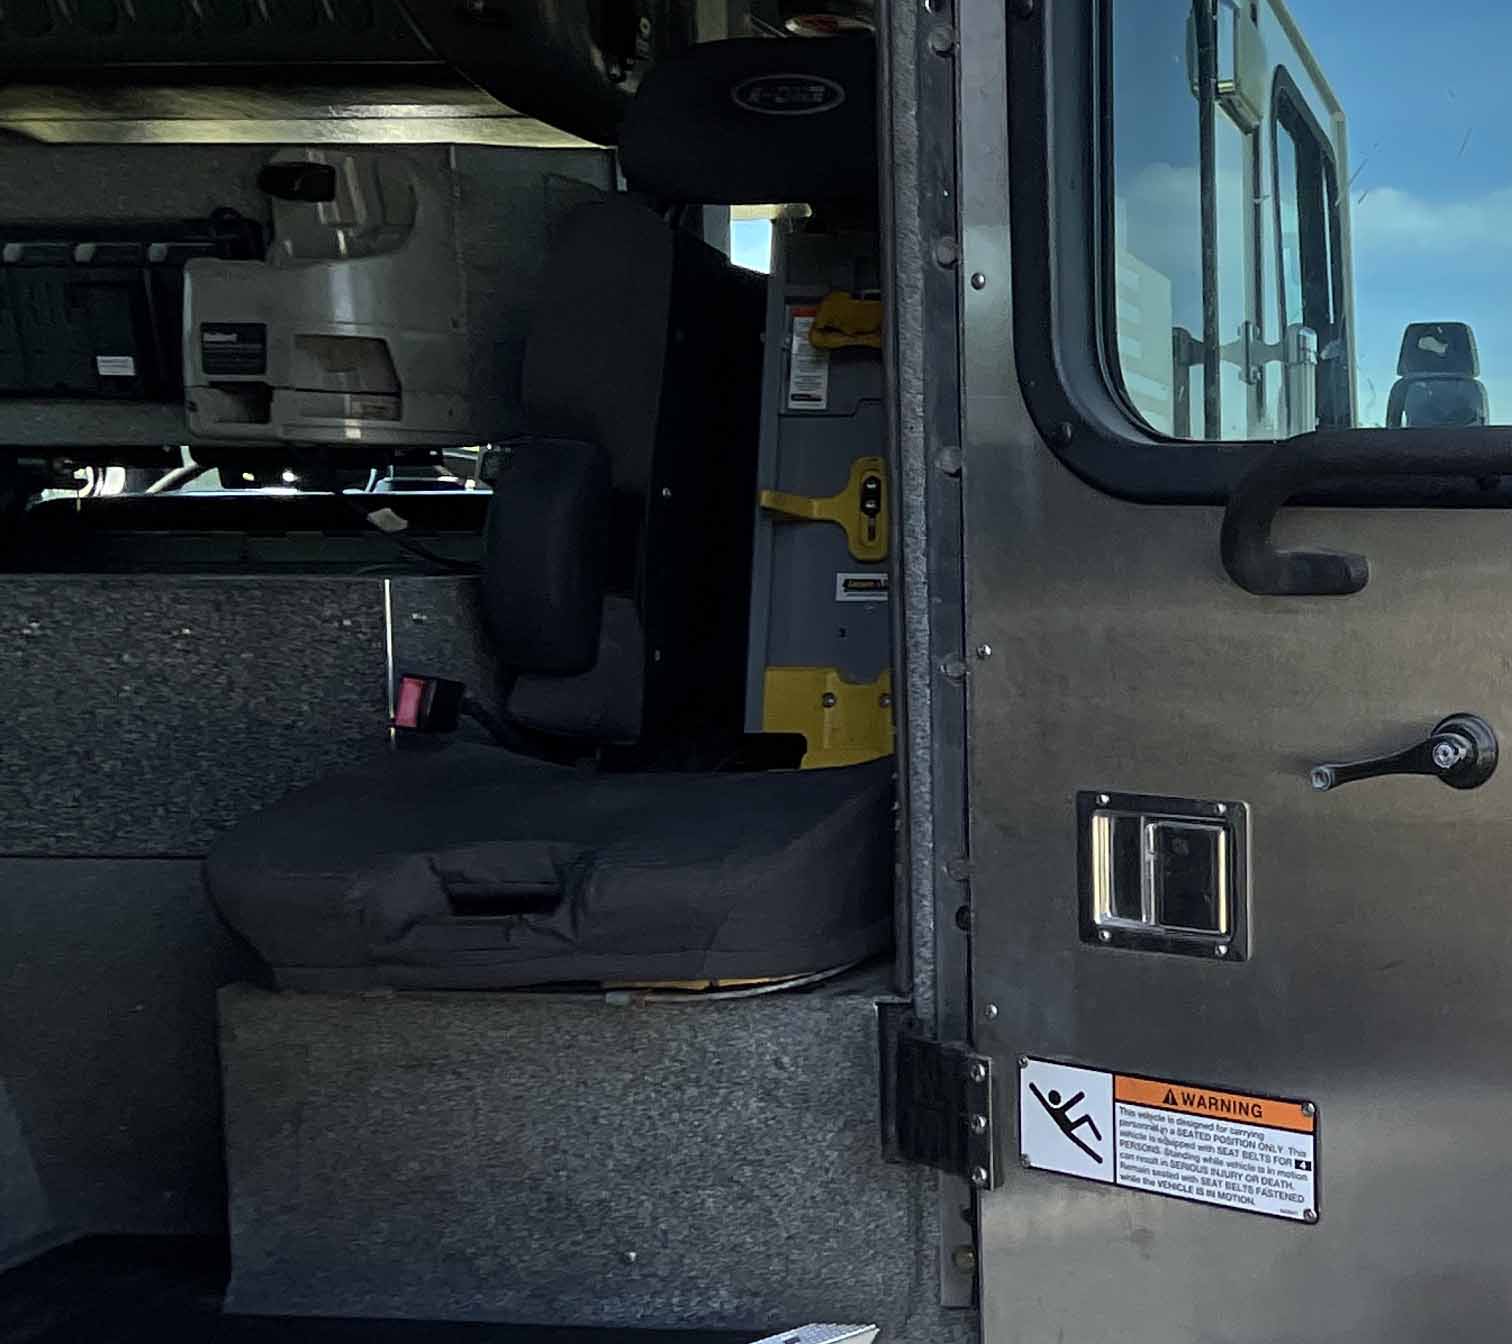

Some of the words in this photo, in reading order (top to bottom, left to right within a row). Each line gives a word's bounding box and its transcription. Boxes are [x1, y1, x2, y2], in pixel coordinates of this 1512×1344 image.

[1181, 1093, 1262, 1118] WARNING
[1119, 1106, 1135, 1116] This
[1137, 1111, 1164, 1121] vehicle
[1175, 1118, 1213, 1131] designed
[1215, 1124, 1227, 1132] for
[1230, 1128, 1264, 1140] carrying
[1119, 1130, 1146, 1140] vehicle
[1216, 1146, 1238, 1157] SEAT
[1242, 1150, 1271, 1162] BELTS
[1273, 1156, 1292, 1166] FOR
[1176, 1128, 1211, 1141] SEATED
[1213, 1134, 1255, 1148] POSITION
[1170, 1159, 1207, 1174] SERIOUS
[1210, 1167, 1243, 1180] INJURY
[1245, 1174, 1258, 1183] OR
[1226, 1160, 1255, 1171] vehicle
[1277, 1170, 1307, 1181] motion
[1142, 1177, 1155, 1186] the
[1157, 1179, 1193, 1193] VEHICLE
[1152, 1168, 1179, 1179] seated
[1200, 1176, 1223, 1188] SEAT
[1225, 1181, 1253, 1194] BELTS
[1255, 1187, 1304, 1203] FASTENED
